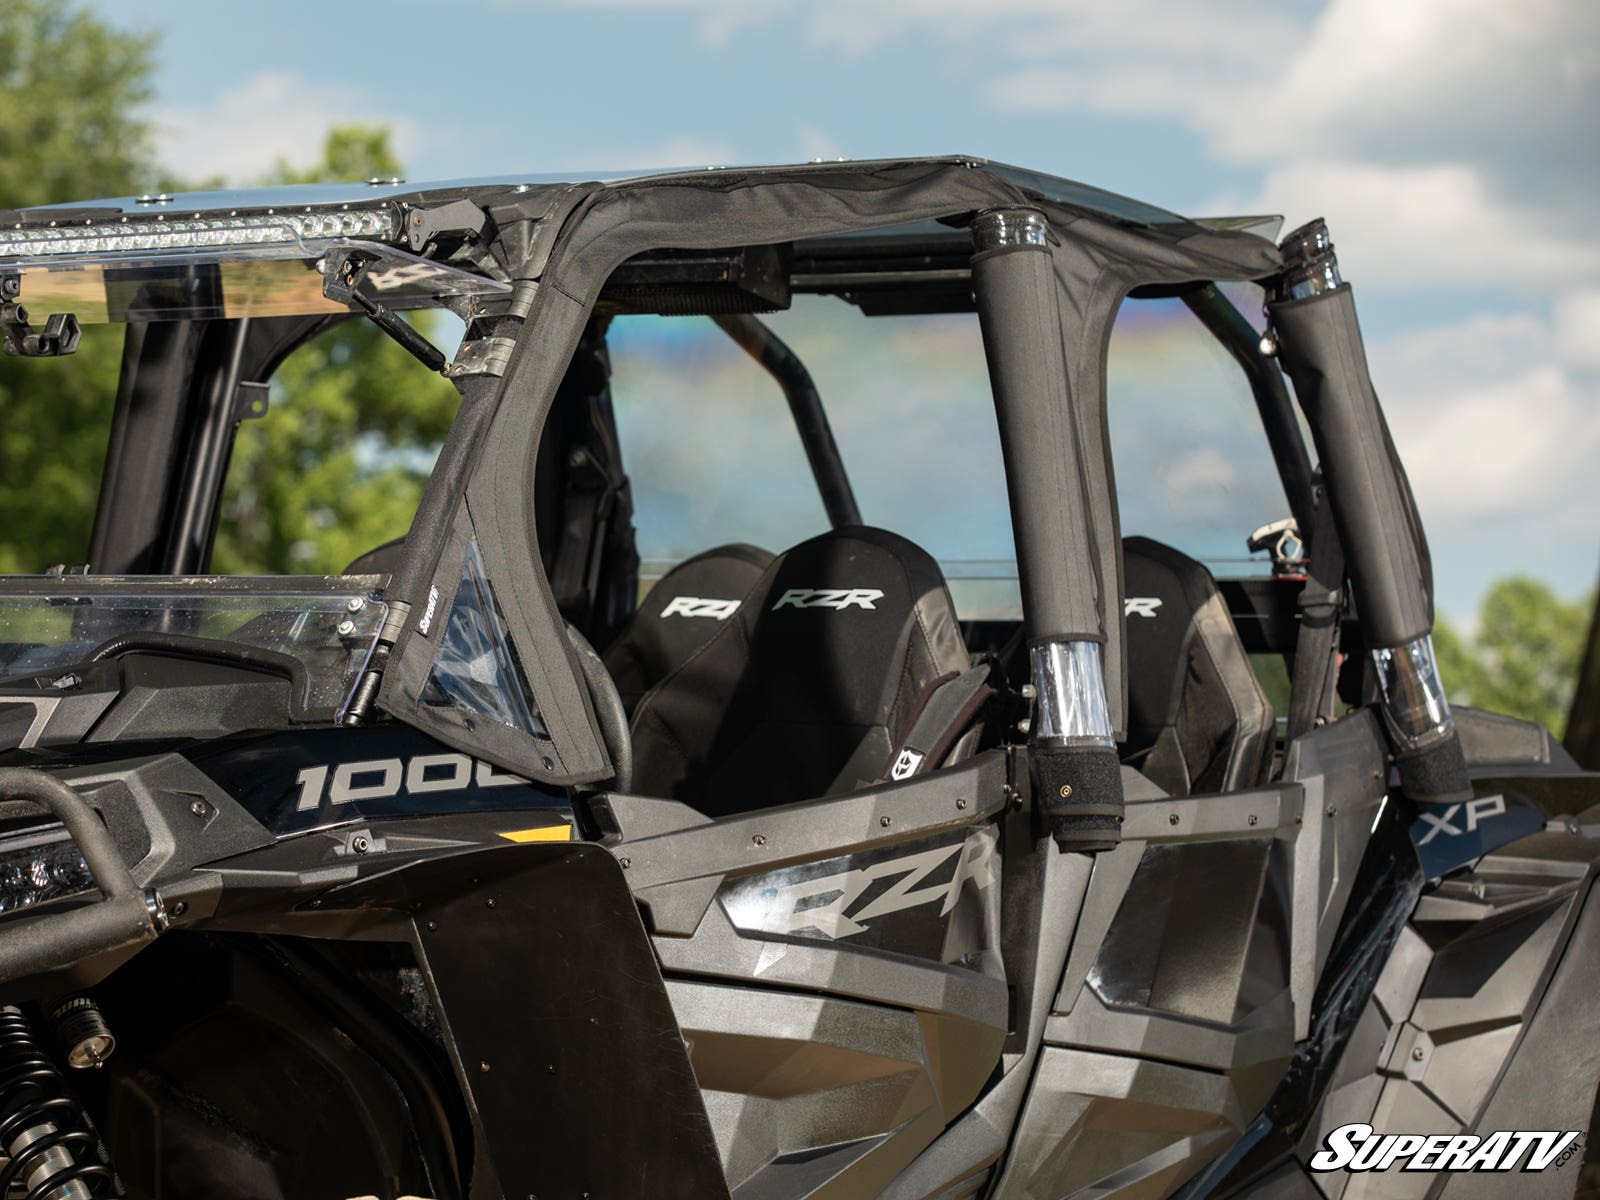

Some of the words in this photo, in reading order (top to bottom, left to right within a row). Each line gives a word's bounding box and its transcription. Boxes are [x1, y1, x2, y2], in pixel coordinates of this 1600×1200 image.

[772, 589, 885, 611] RZR
[1417, 794, 1506, 846] XP
[754, 831, 996, 976] RZR
